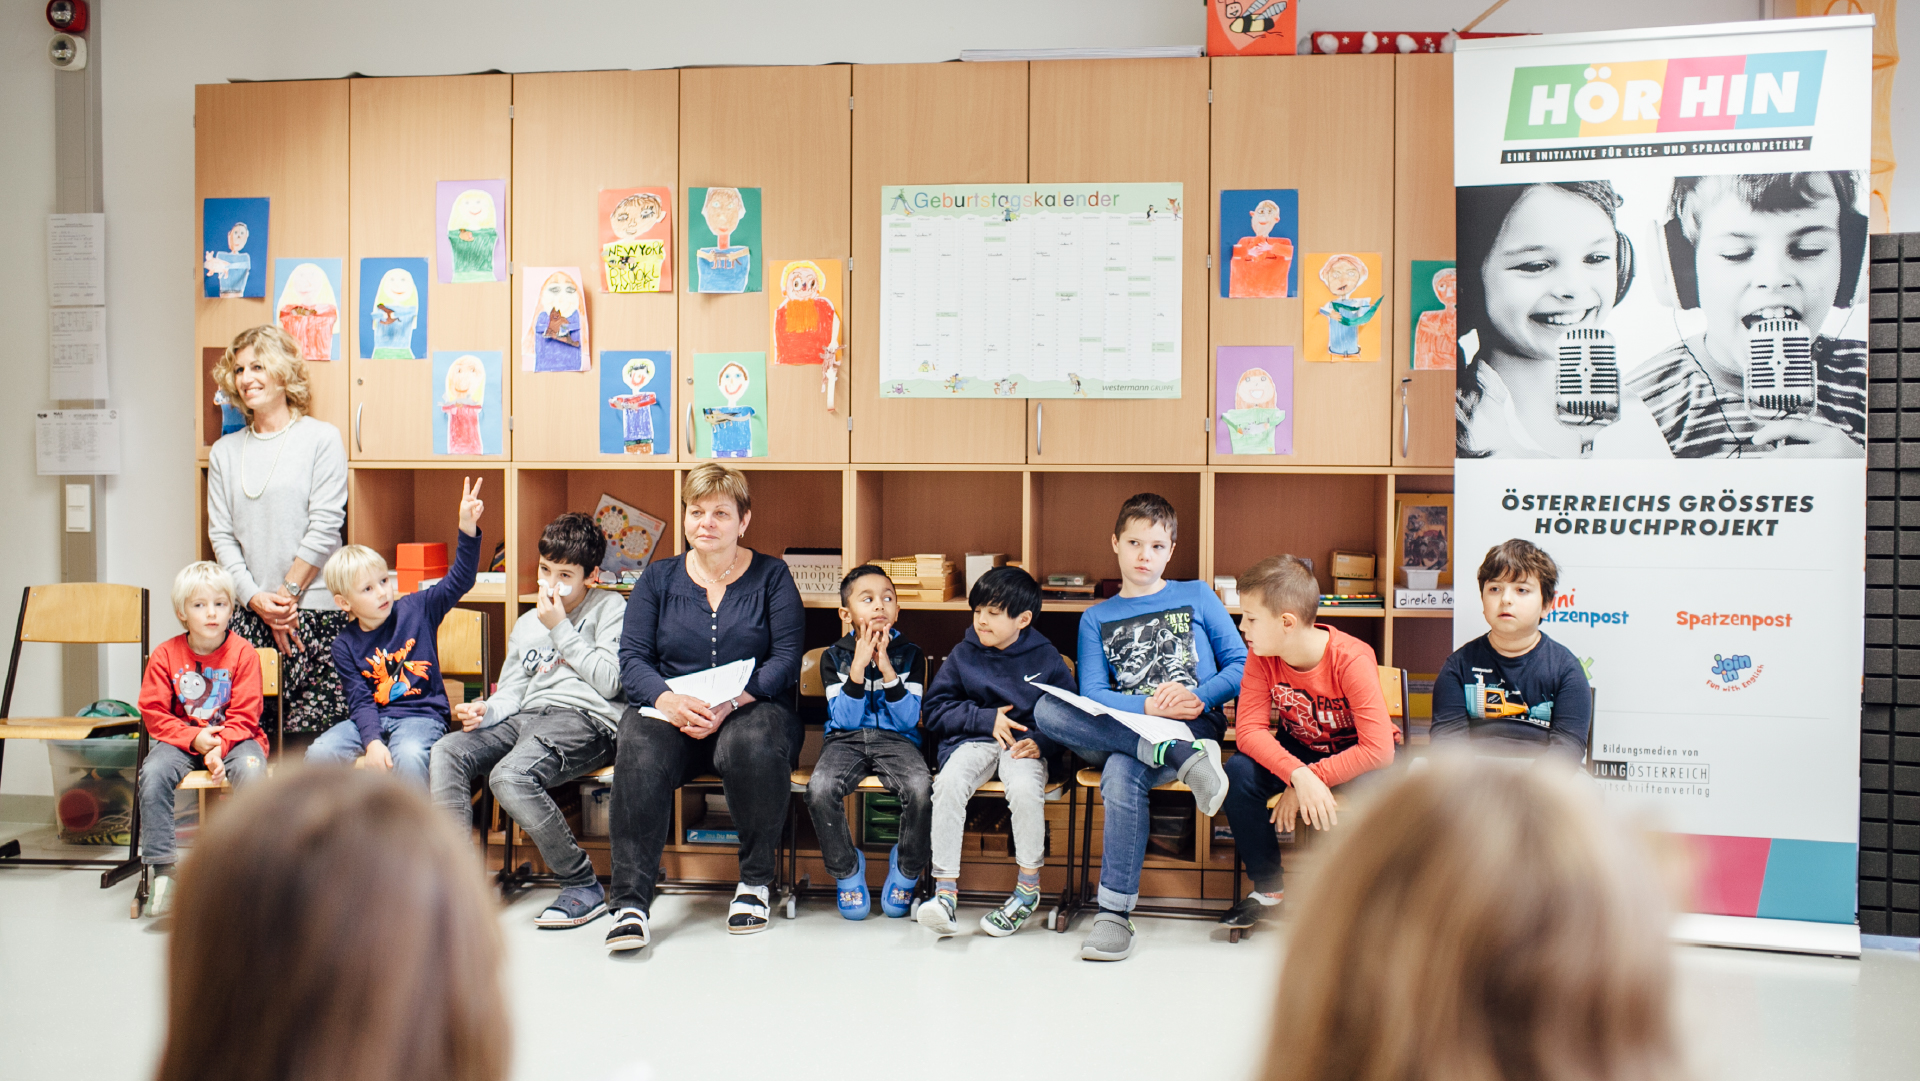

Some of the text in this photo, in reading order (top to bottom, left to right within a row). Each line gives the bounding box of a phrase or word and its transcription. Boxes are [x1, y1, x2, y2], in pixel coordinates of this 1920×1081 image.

[1528, 66, 1801, 126] HÖR HIN
[1506, 139, 1805, 163] EINE INITIATIVE FÜR LESE- UND SPRACHKOMPETENZ
[913, 191, 1120, 211] Geburtstagskalender
[1102, 384, 1174, 392] westermann GRUPPE
[1501, 488, 1815, 513] ÖSTERREICHS GRÖSSTES
[1534, 512, 1780, 536] HÖRBUCHPROJEKT
[1399, 591, 1454, 606] direkte Re
[1169, 613, 1191, 625] NYC
[1171, 622, 1190, 634] 763
[1676, 611, 1793, 631] Spatzenpost
[1711, 653, 1752, 675] join
[1706, 679, 1721, 692] Fun
[1741, 664, 1765, 689] English
[1721, 669, 1740, 683] in
[1316, 695, 1350, 711] FAST
[1317, 711, 1338, 729] 4
[1602, 743, 1699, 757] Bildungsmedien von
[1598, 782, 1711, 798] itschriftenverlag
